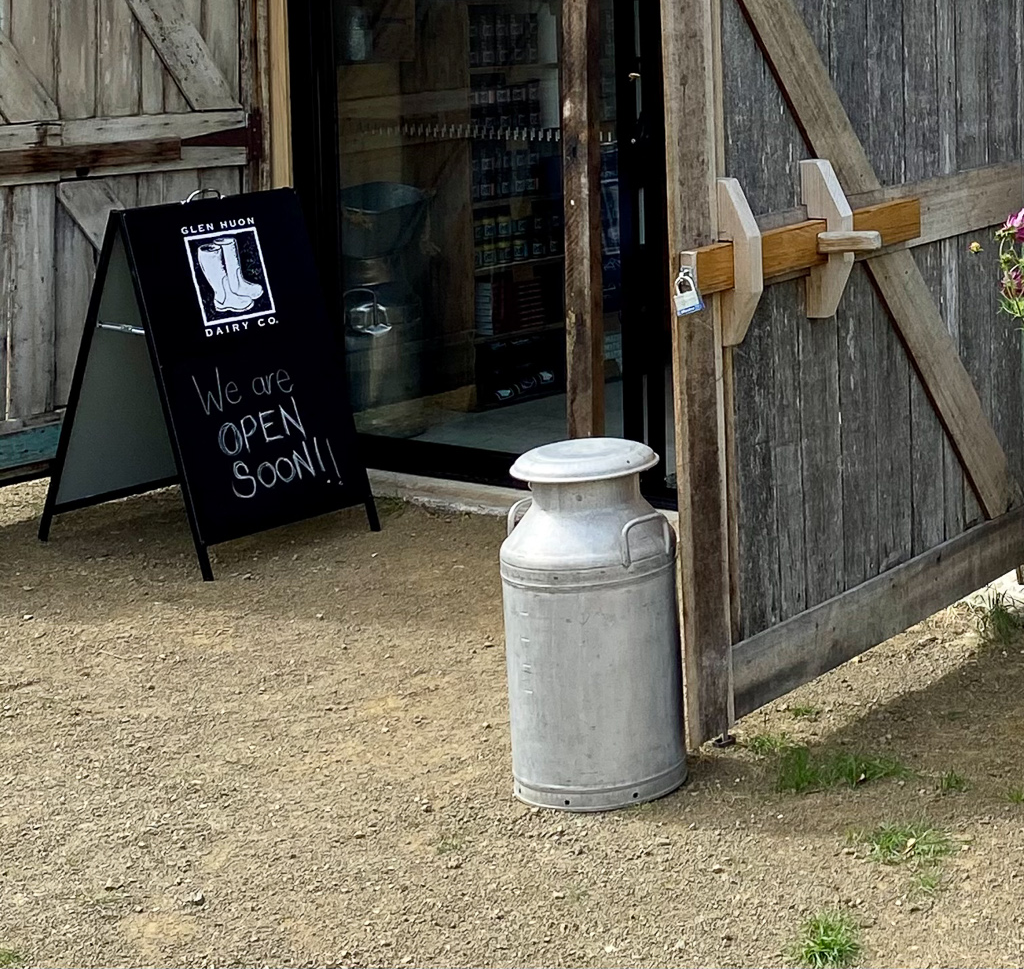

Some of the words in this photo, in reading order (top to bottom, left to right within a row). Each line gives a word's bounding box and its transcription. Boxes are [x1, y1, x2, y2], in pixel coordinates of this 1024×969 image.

[181, 222, 215, 235] GLEN
[220, 217, 256, 228] HUON
[205, 321, 250, 337] DAIRY
[257, 317, 279, 328] CO.
[192, 367, 242, 416] We
[252, 369, 295, 396] are
[218, 396, 308, 456] OPEN
[231, 436, 344, 499] SOON!!
